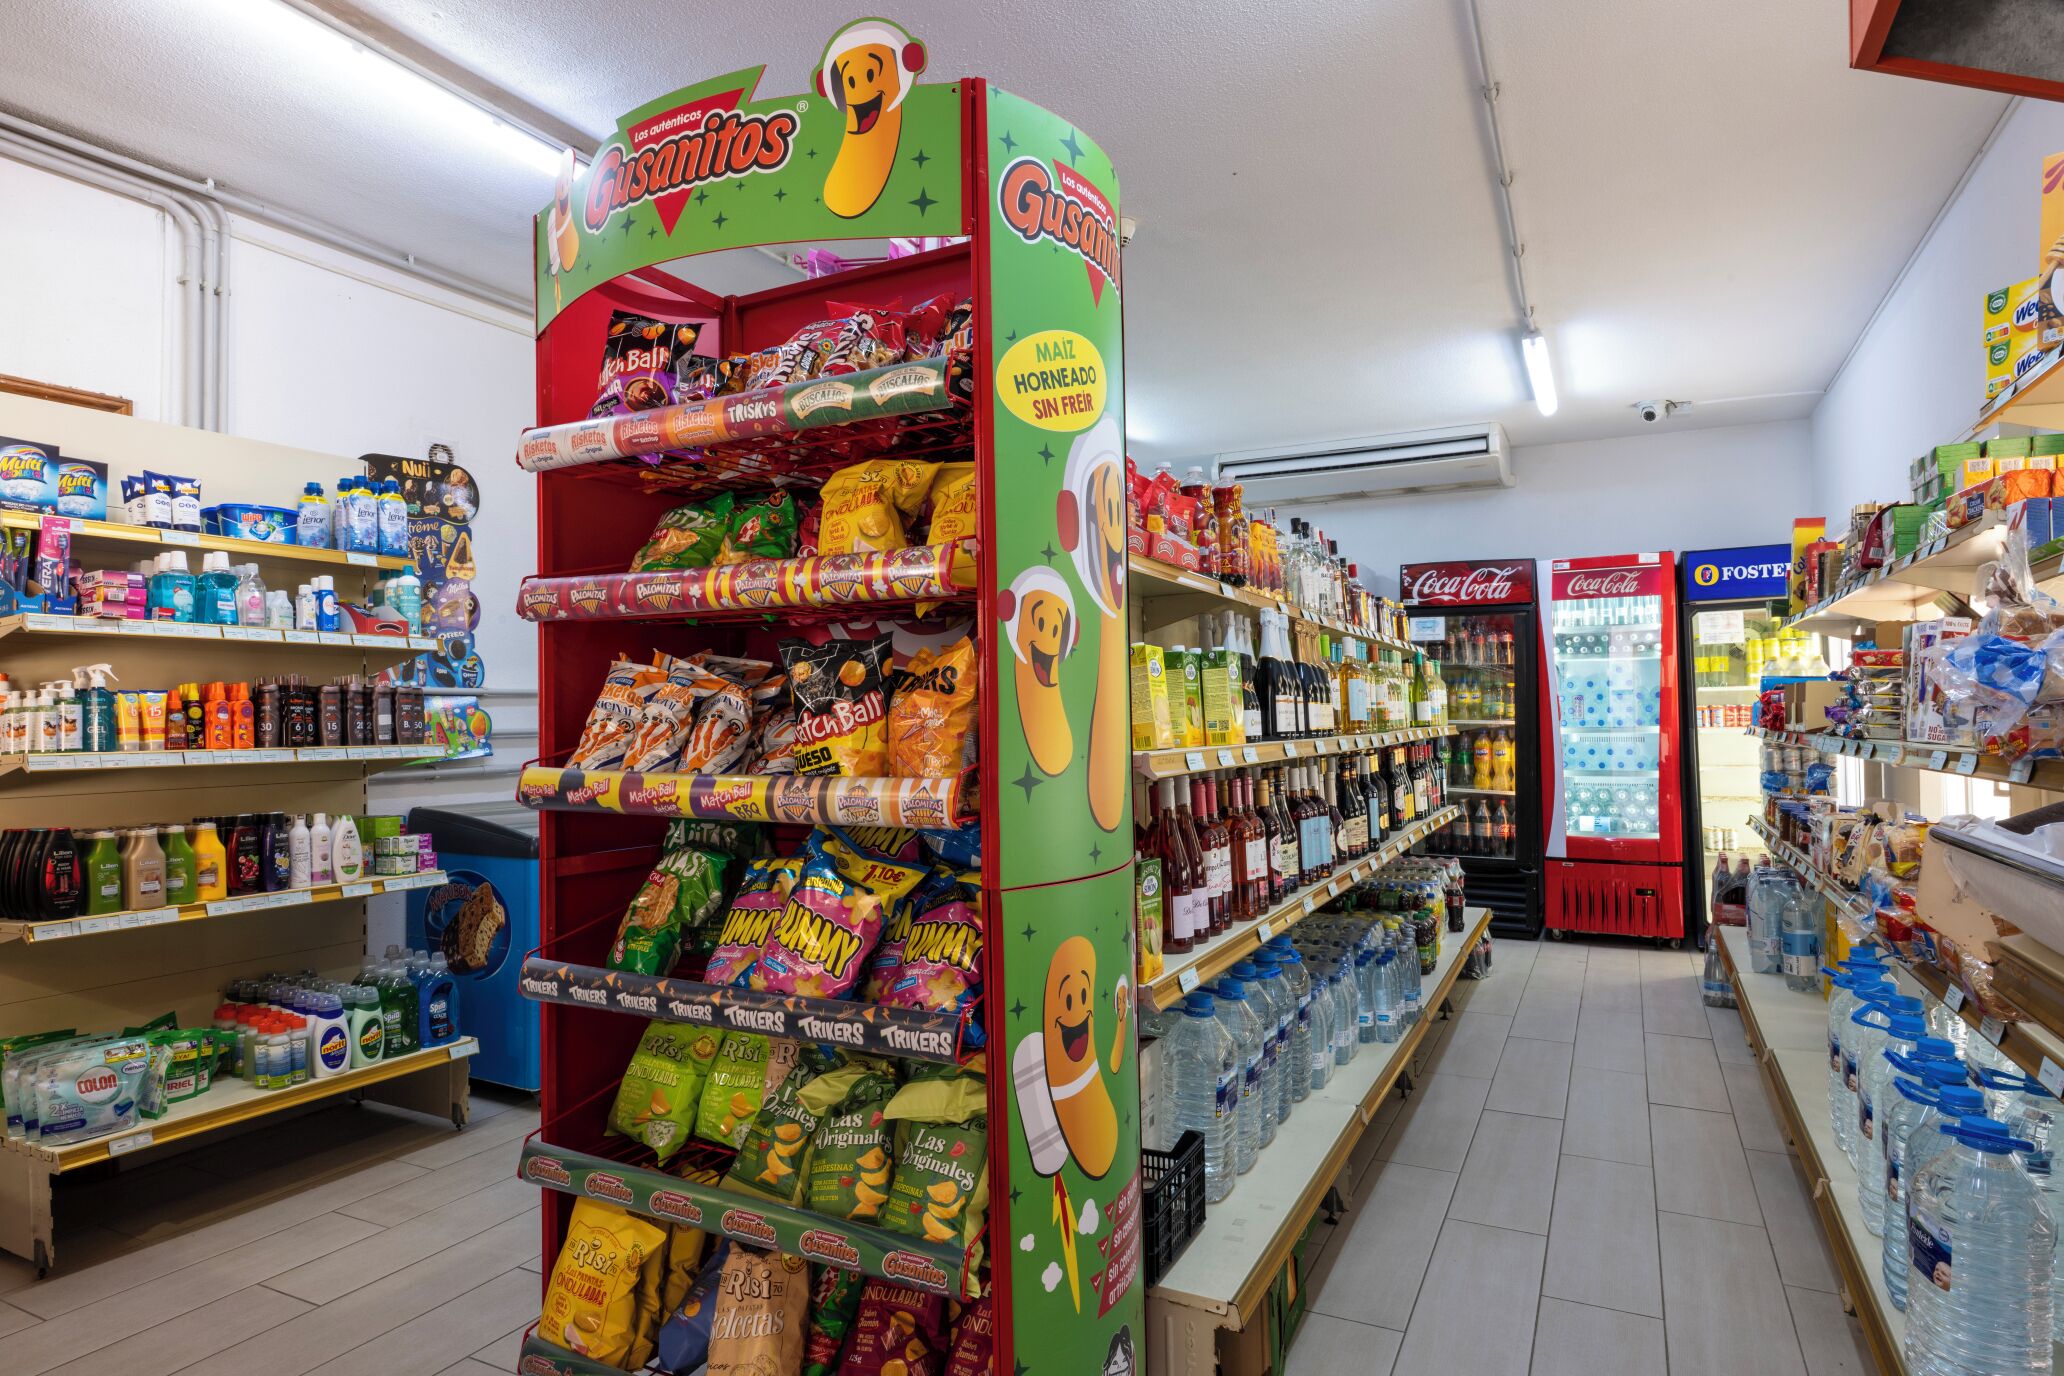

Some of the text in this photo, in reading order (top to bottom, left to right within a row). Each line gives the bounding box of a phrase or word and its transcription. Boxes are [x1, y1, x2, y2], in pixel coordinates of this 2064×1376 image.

[634, 110, 702, 143] Los auténticos
[585, 113, 795, 230] Gusanitos
[1062, 172, 1075, 190] Los
[599, 359, 625, 391] atch
[1013, 366, 1097, 395] HORNEADO
[1032, 398, 1060, 420] SIN
[620, 420, 659, 440] Risketos
[672, 411, 715, 432] Risketos
[0, 456, 43, 471] Multi
[408, 521, 440, 533] trême
[636, 582, 682, 599] PALOMITAS
[1412, 566, 1522, 603] Coca-Cola
[1566, 570, 1643, 596] Coca-Cola
[600, 683, 644, 707] sketos
[150, 706, 162, 716] 15
[595, 700, 632, 716] RIGINAL
[832, 692, 881, 731] Ball
[260, 722, 272, 731] 30
[327, 722, 338, 731] 15
[566, 778, 611, 804] Match Ball
[629, 779, 677, 804] Match Ball
[700, 780, 753, 807] Match Ball
[777, 796, 815, 809] PALOMITAS
[837, 795, 879, 810] PALOMITAS
[733, 801, 762, 820] BBQ
[902, 797, 944, 812] PALOMITAS
[522, 977, 558, 997] TRIKERS
[569, 985, 607, 1005] TRIKERS
[616, 991, 657, 1013] TRIKERS
[669, 1000, 712, 1022] TRIKERS
[724, 1005, 785, 1033] TRIKERS
[798, 1016, 864, 1045] TRIKERS
[320, 1038, 347, 1055] norit
[361, 1029, 383, 1045] norit
[647, 1035, 683, 1062] Risi
[880, 1025, 952, 1056] TRIKERS
[723, 1036, 762, 1063] Risi
[77, 1073, 118, 1095] COLON
[167, 1079, 193, 1091] RIEL
[831, 1112, 863, 1129] Las
[816, 1127, 893, 1154] Originales
[914, 1129, 946, 1154] Las
[902, 1142, 975, 1192] Originales
[586, 1173, 633, 1202] Gusanitos
[650, 1191, 702, 1222] Gusanitos
[722, 1210, 776, 1242] Gusanitos
[573, 1239, 617, 1275] Risi
[801, 1231, 858, 1265] Gusanitos
[883, 1250, 948, 1287] Gusanitos
[1108, 1263, 1119, 1282] sin
[725, 1261, 772, 1302] Risi
